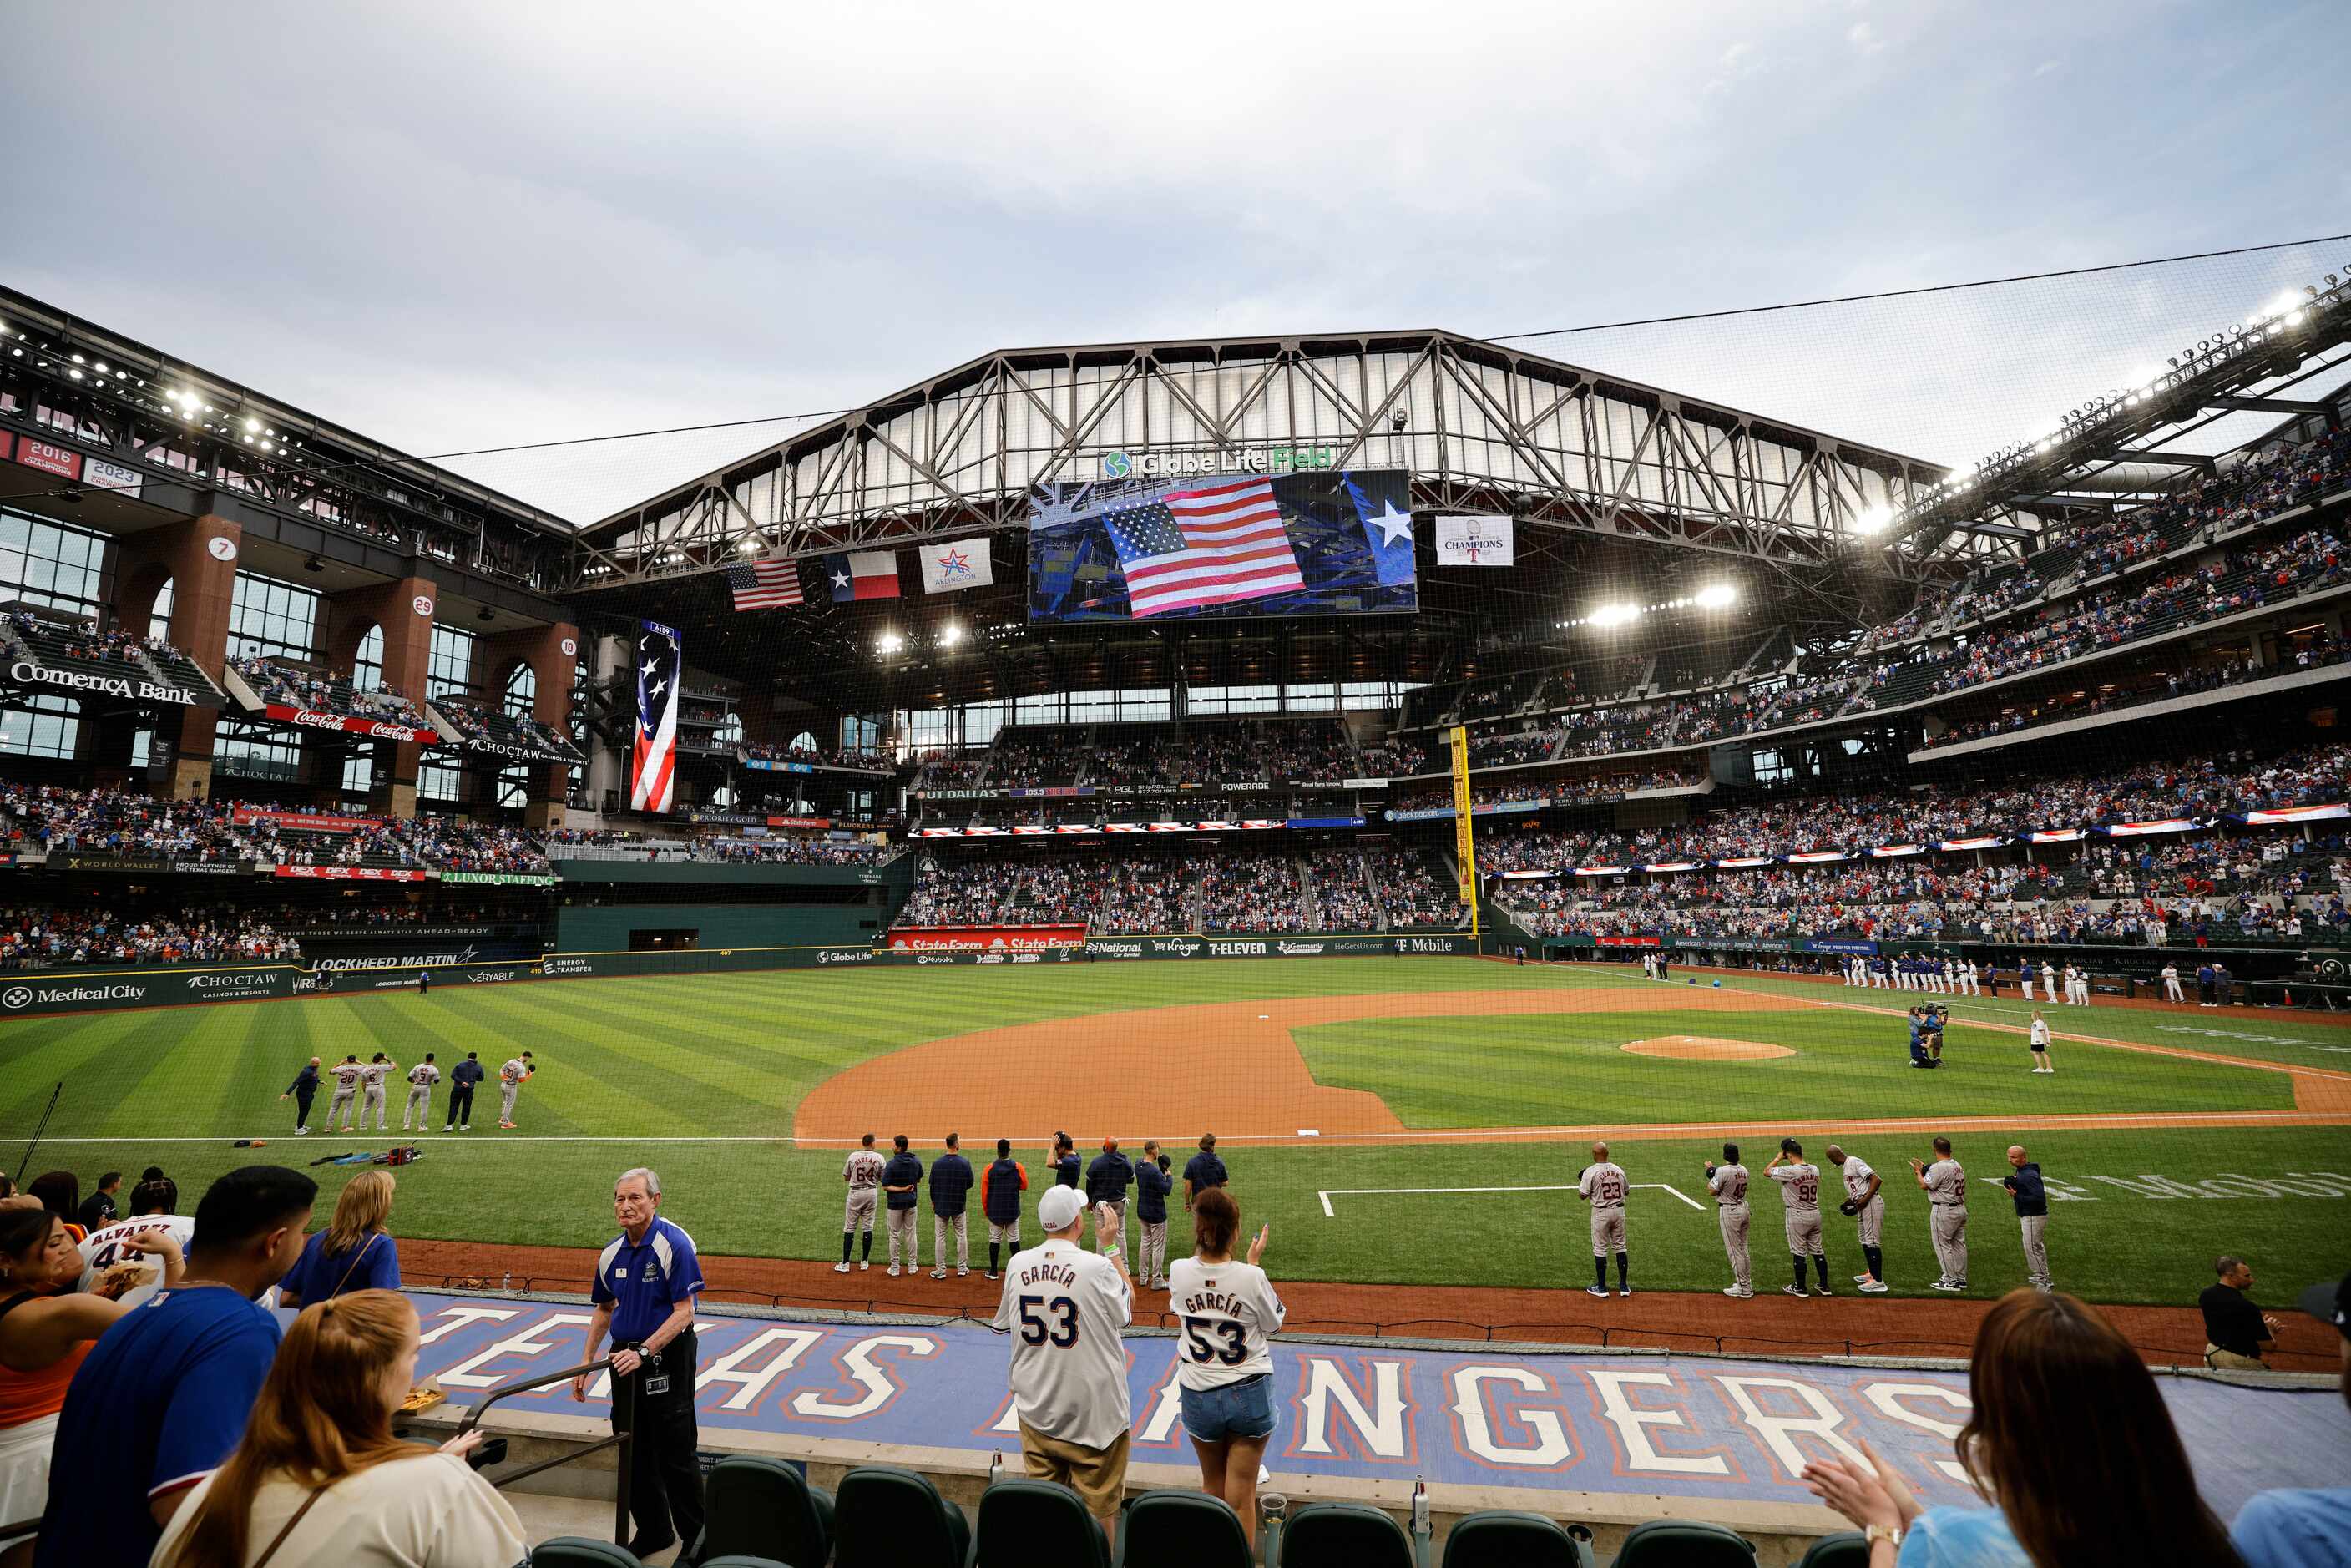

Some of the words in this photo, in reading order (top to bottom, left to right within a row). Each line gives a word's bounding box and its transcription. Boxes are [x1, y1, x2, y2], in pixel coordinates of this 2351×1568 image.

[31, 442, 72, 463] 2016
[1141, 452, 1215, 474] Globe
[1221, 448, 1267, 471] Life
[1272, 443, 1330, 468] Field
[94, 462, 134, 483] 2023
[218, 542, 228, 554] 7
[1445, 539, 1503, 549] CHAMPIONS
[416, 599, 431, 613] 29
[564, 641, 574, 651] 10
[137, 681, 196, 705] Bank
[477, 741, 541, 761] CHOCTAW
[1221, 782, 1269, 791] POWERADE
[926, 791, 943, 799] UT
[946, 789, 999, 799] DALLAS
[700, 815, 735, 823] PRIORITY
[83, 860, 120, 869] WORLD
[124, 862, 159, 870] WALLET
[326, 867, 351, 875] DEX
[359, 868, 382, 877] DEX
[391, 869, 414, 878] DEX
[453, 872, 496, 883] LUXOR
[499, 874, 554, 886] STAFFING
[1098, 942, 1141, 953] National
[1167, 938, 1201, 957] Kroger
[1290, 942, 1325, 950] Germania
[1335, 942, 1385, 950] HeGetsUs.com
[1412, 938, 1453, 952] Mobile
[311, 956, 397, 972] LOCKHEED
[401, 954, 458, 967] MARTIN
[830, 953, 856, 962] Globe
[857, 952, 872, 960] Life
[198, 974, 278, 987] CHOCTAW
[38, 986, 109, 1003] Medical
[111, 985, 147, 1000] City
[341, 1074, 355, 1084] 20
[369, 1073, 376, 1083] 6
[420, 1072, 427, 1082] 3
[856, 1166, 875, 1182] 64
[1601, 1181, 1622, 1200] 23
[1799, 1185, 1818, 1202] 99
[1849, 1183, 1858, 1194] 8
[1021, 1262, 1077, 1290] GARCÍA
[1185, 1293, 1242, 1318] GARCÍA
[1019, 1295, 1080, 1350] 53
[1186, 1316, 1248, 1367] 53
[420, 1305, 937, 1419] TEAS
